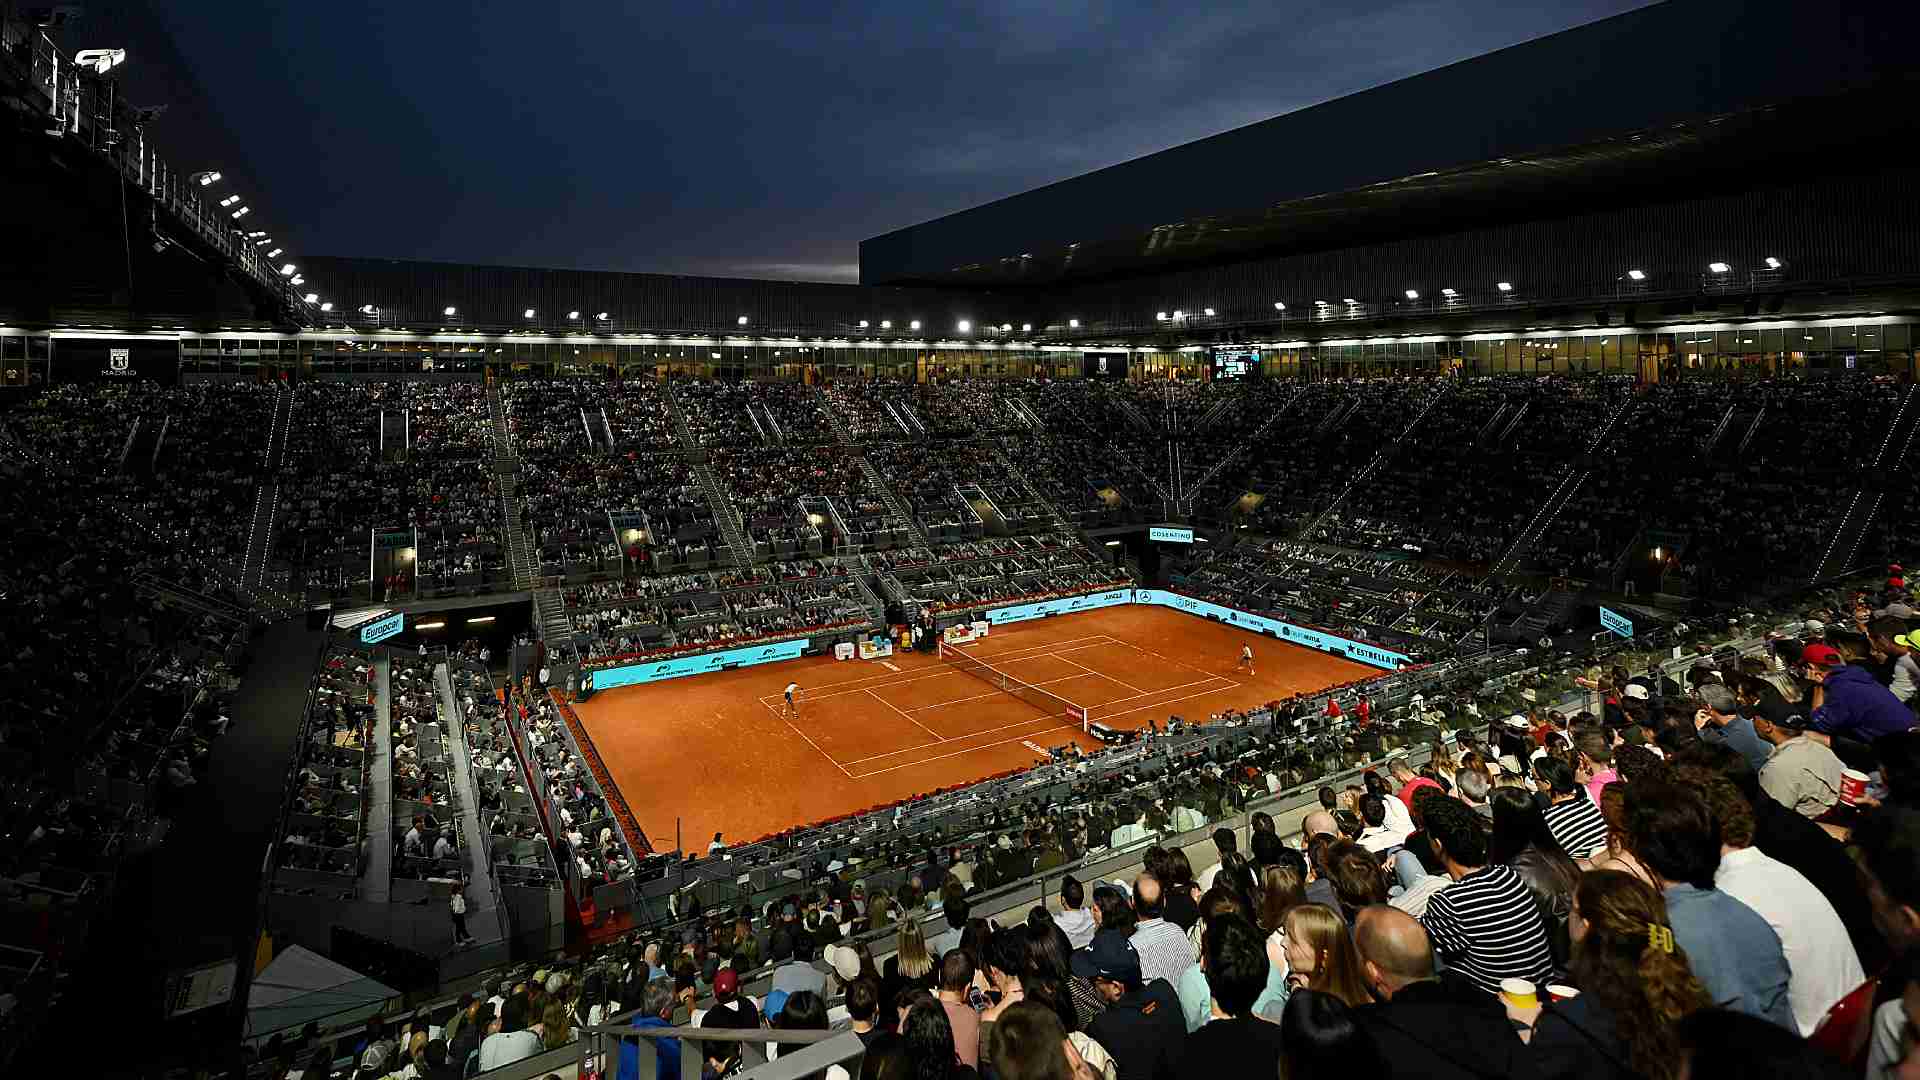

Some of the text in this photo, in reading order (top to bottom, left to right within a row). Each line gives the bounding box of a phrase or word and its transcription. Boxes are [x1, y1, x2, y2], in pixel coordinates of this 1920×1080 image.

[1185, 600, 1198, 610] PIF
[366, 619, 400, 639] Europcar
[1602, 610, 1630, 633] Europcar
[1356, 647, 1391, 665] ESTRELLA
